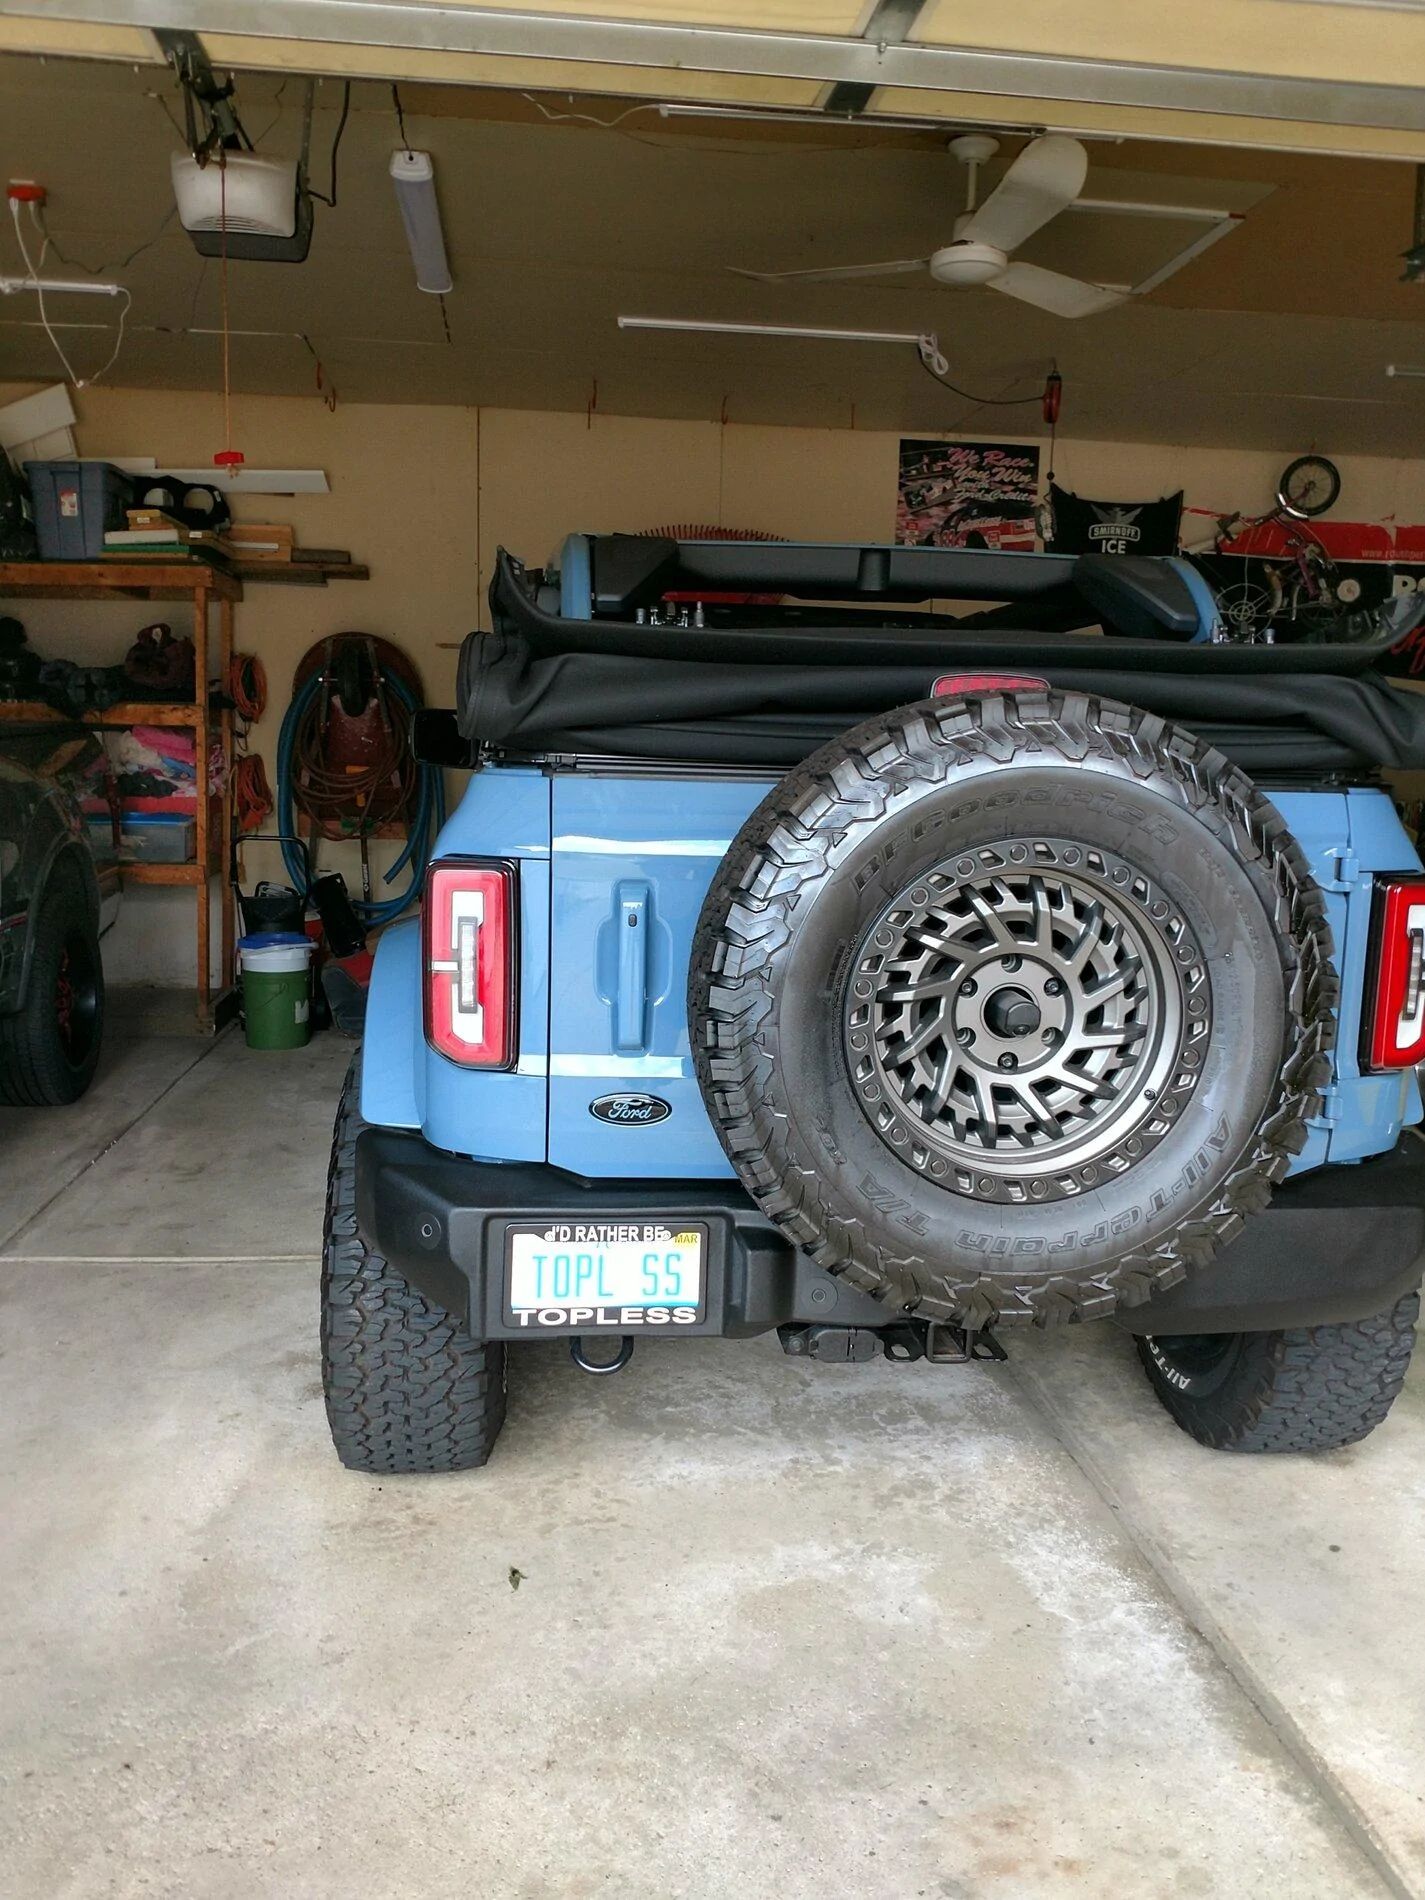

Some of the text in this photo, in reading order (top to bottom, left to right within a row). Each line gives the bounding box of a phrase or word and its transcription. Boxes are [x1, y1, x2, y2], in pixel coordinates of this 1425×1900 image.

[1093, 526, 1137, 538] SMIRNOFF
[1101, 539, 1127, 554] ICE
[851, 782, 1180, 895] BFGoodrich
[608, 1098, 654, 1119] Ford
[955, 1110, 1232, 1255] All-Terrain
[856, 1169, 932, 1237] T/A
[575, 1225, 640, 1242] RATHER
[643, 1225, 665, 1242] BE
[674, 1233, 698, 1244] MAR
[532, 1253, 682, 1298] TOPL SS
[512, 1306, 697, 1327] TOPLESS
